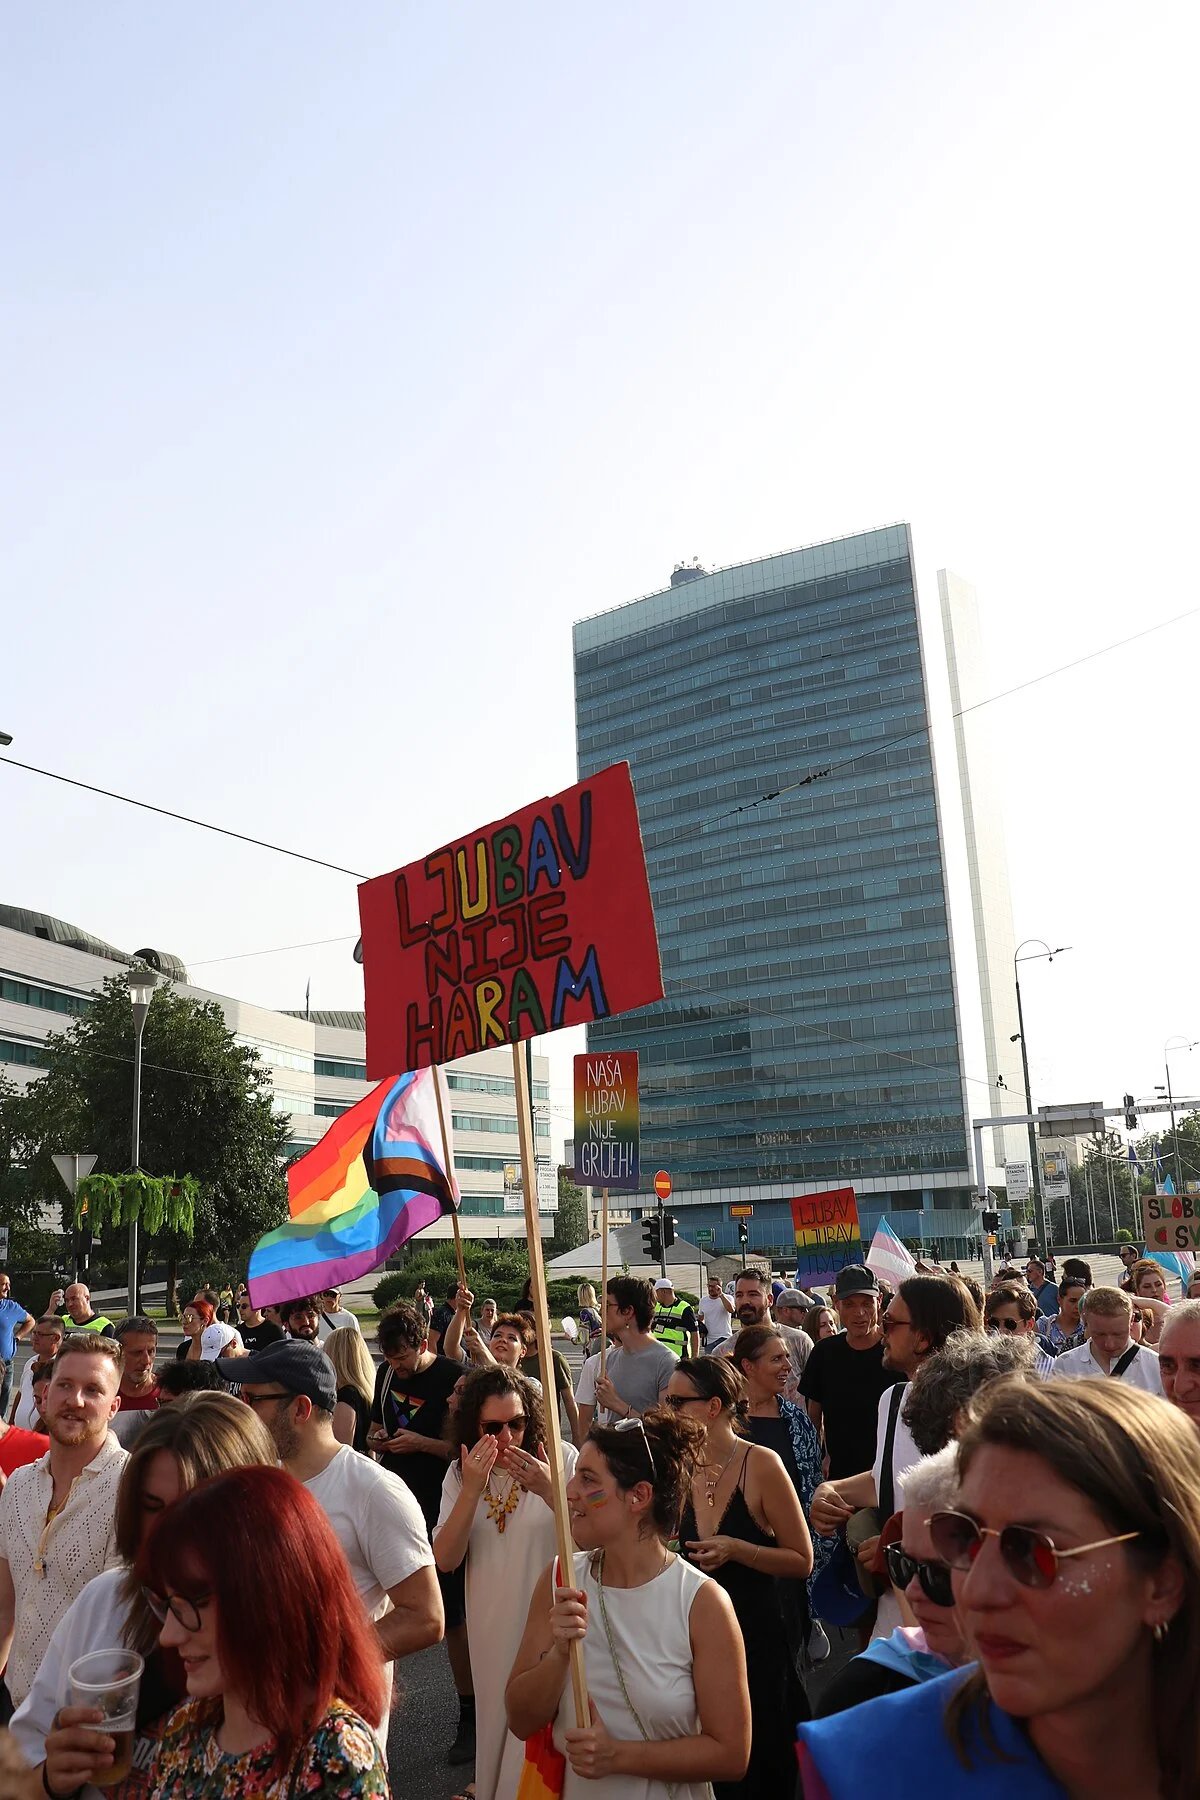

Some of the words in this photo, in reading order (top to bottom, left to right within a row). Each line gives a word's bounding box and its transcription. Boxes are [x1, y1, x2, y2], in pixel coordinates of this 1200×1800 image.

[394, 790, 591, 949] LJUBAV
[425, 891, 572, 997] NIJE
[406, 944, 611, 1072] HARAM
[586, 1054, 623, 1087] NAŠA
[588, 1120, 617, 1140] NIJE
[581, 1140, 634, 1179] GRIJEH!
[799, 1196, 850, 1225] LJUBAV
[802, 1222, 854, 1250] LJUBAV
